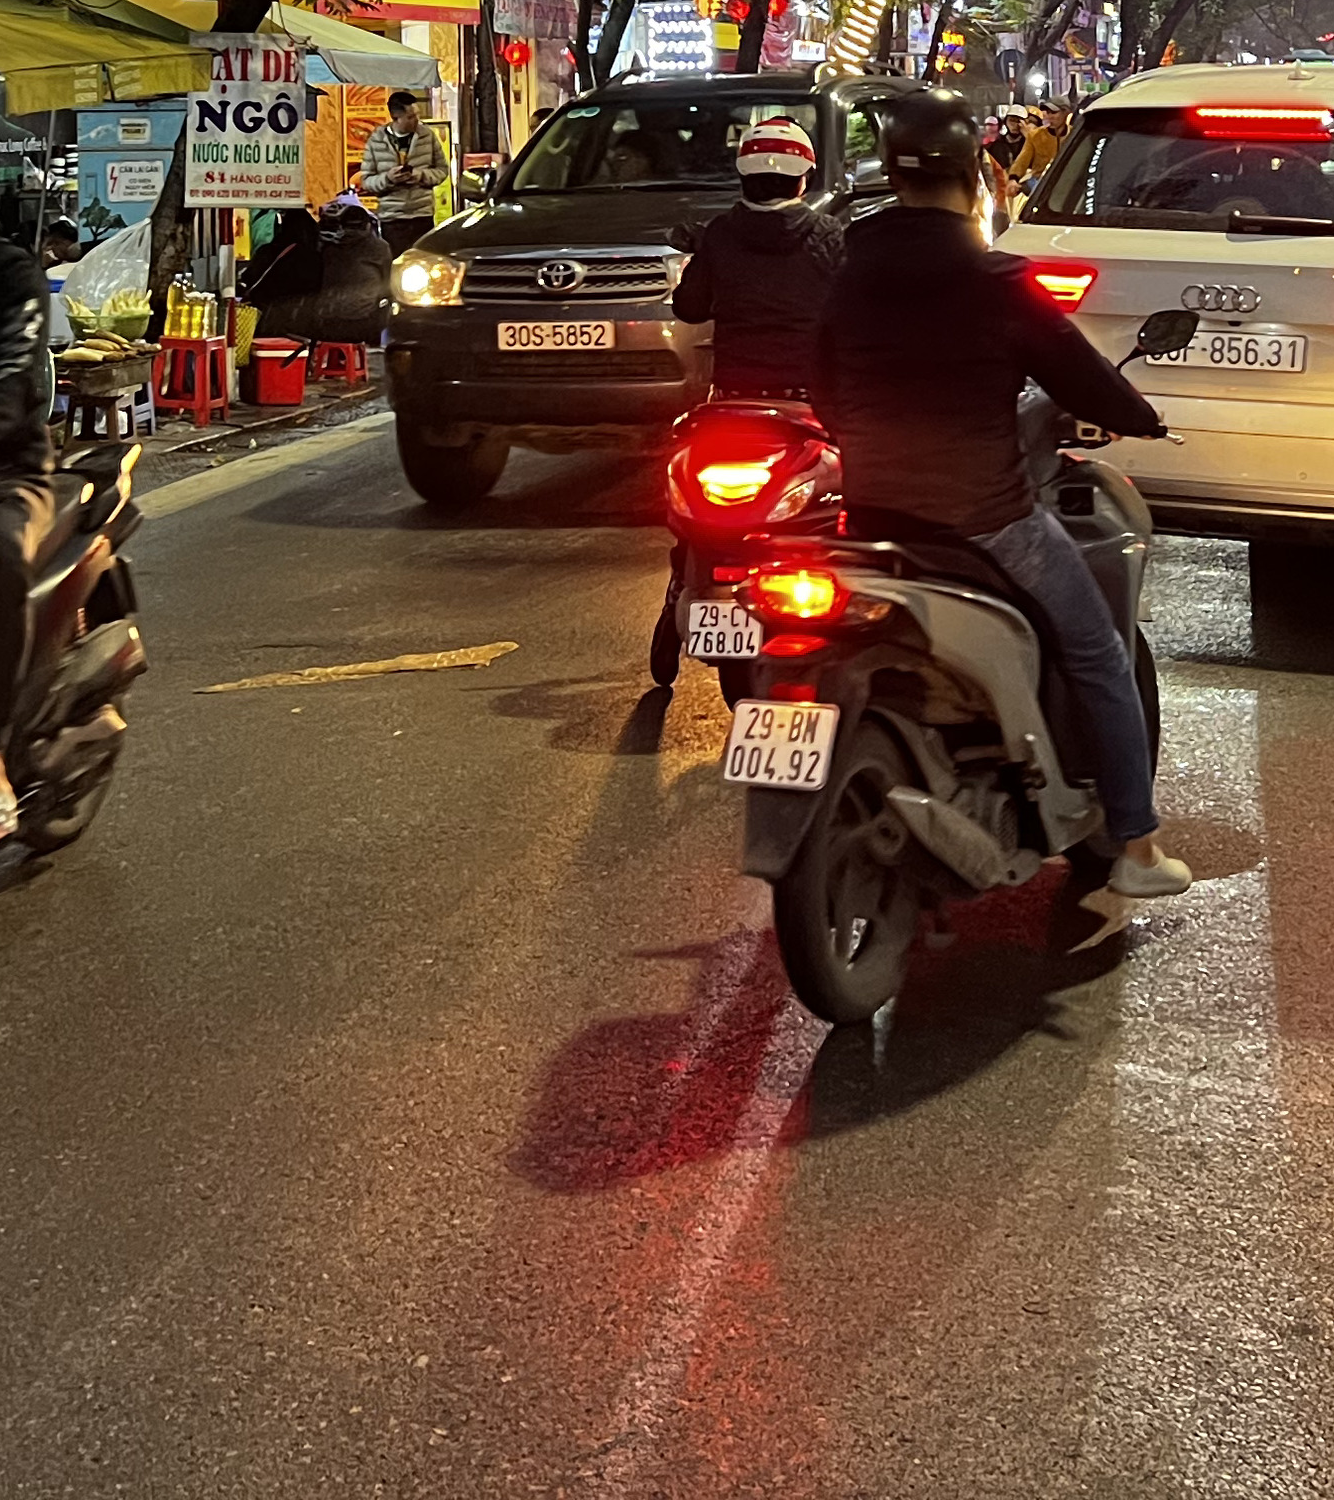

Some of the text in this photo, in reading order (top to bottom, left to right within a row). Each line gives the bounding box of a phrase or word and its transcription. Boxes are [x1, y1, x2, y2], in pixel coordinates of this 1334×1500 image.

[195, 92, 299, 134] NGÔ
[233, 140, 260, 164] NGÔ
[265, 144, 300, 169] LẠNH
[504, 324, 607, 347] 30S-5852
[691, 631, 756, 654] 768.04
[729, 745, 821, 782] 004.92
